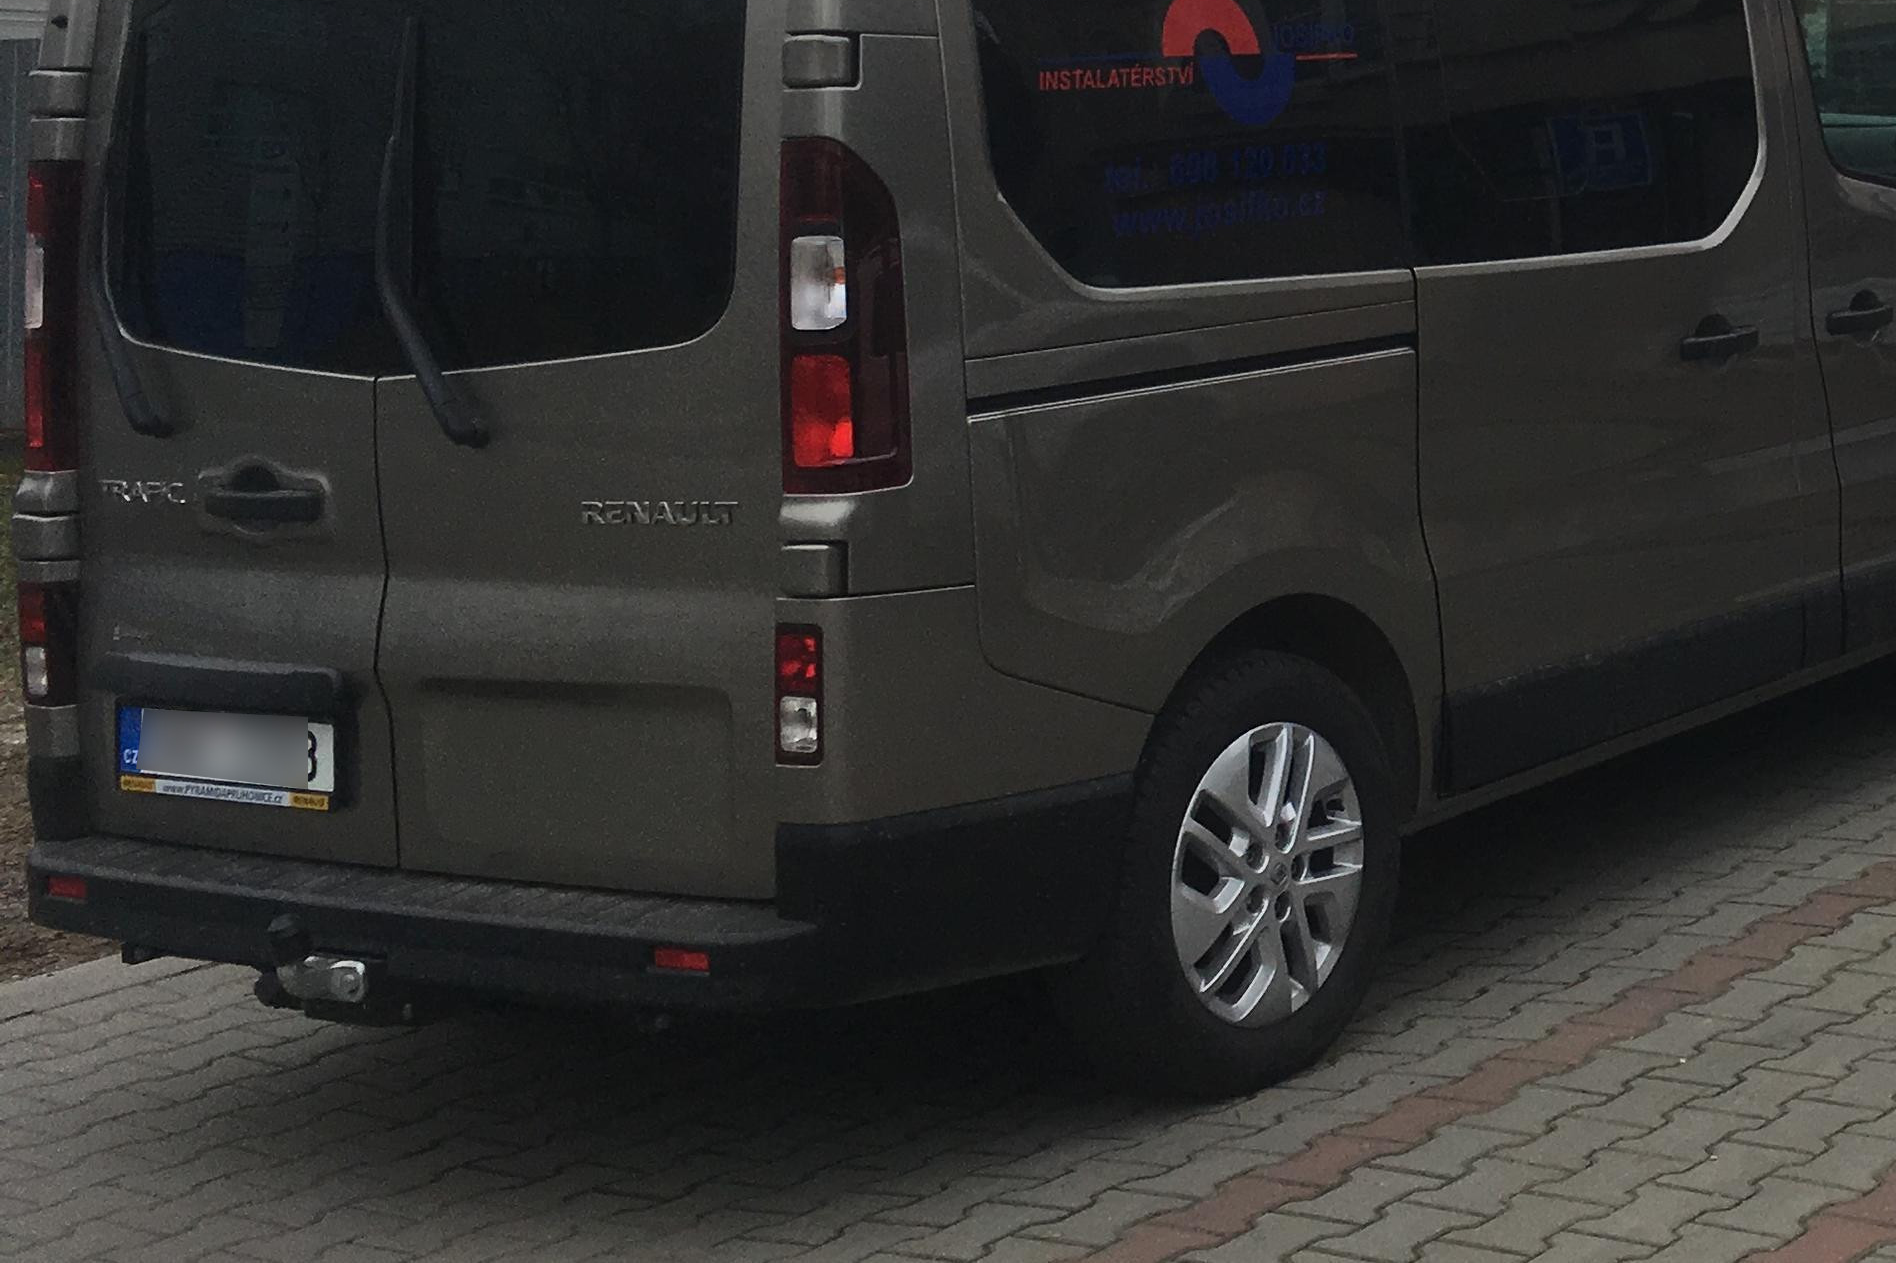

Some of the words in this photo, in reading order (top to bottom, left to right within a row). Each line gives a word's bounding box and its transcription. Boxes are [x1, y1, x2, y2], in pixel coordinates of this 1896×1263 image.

[1039, 62, 1195, 91] INSTALATÉRSTVÍ
[580, 500, 740, 526] RENAULT
[123, 747, 139, 765] CZ
